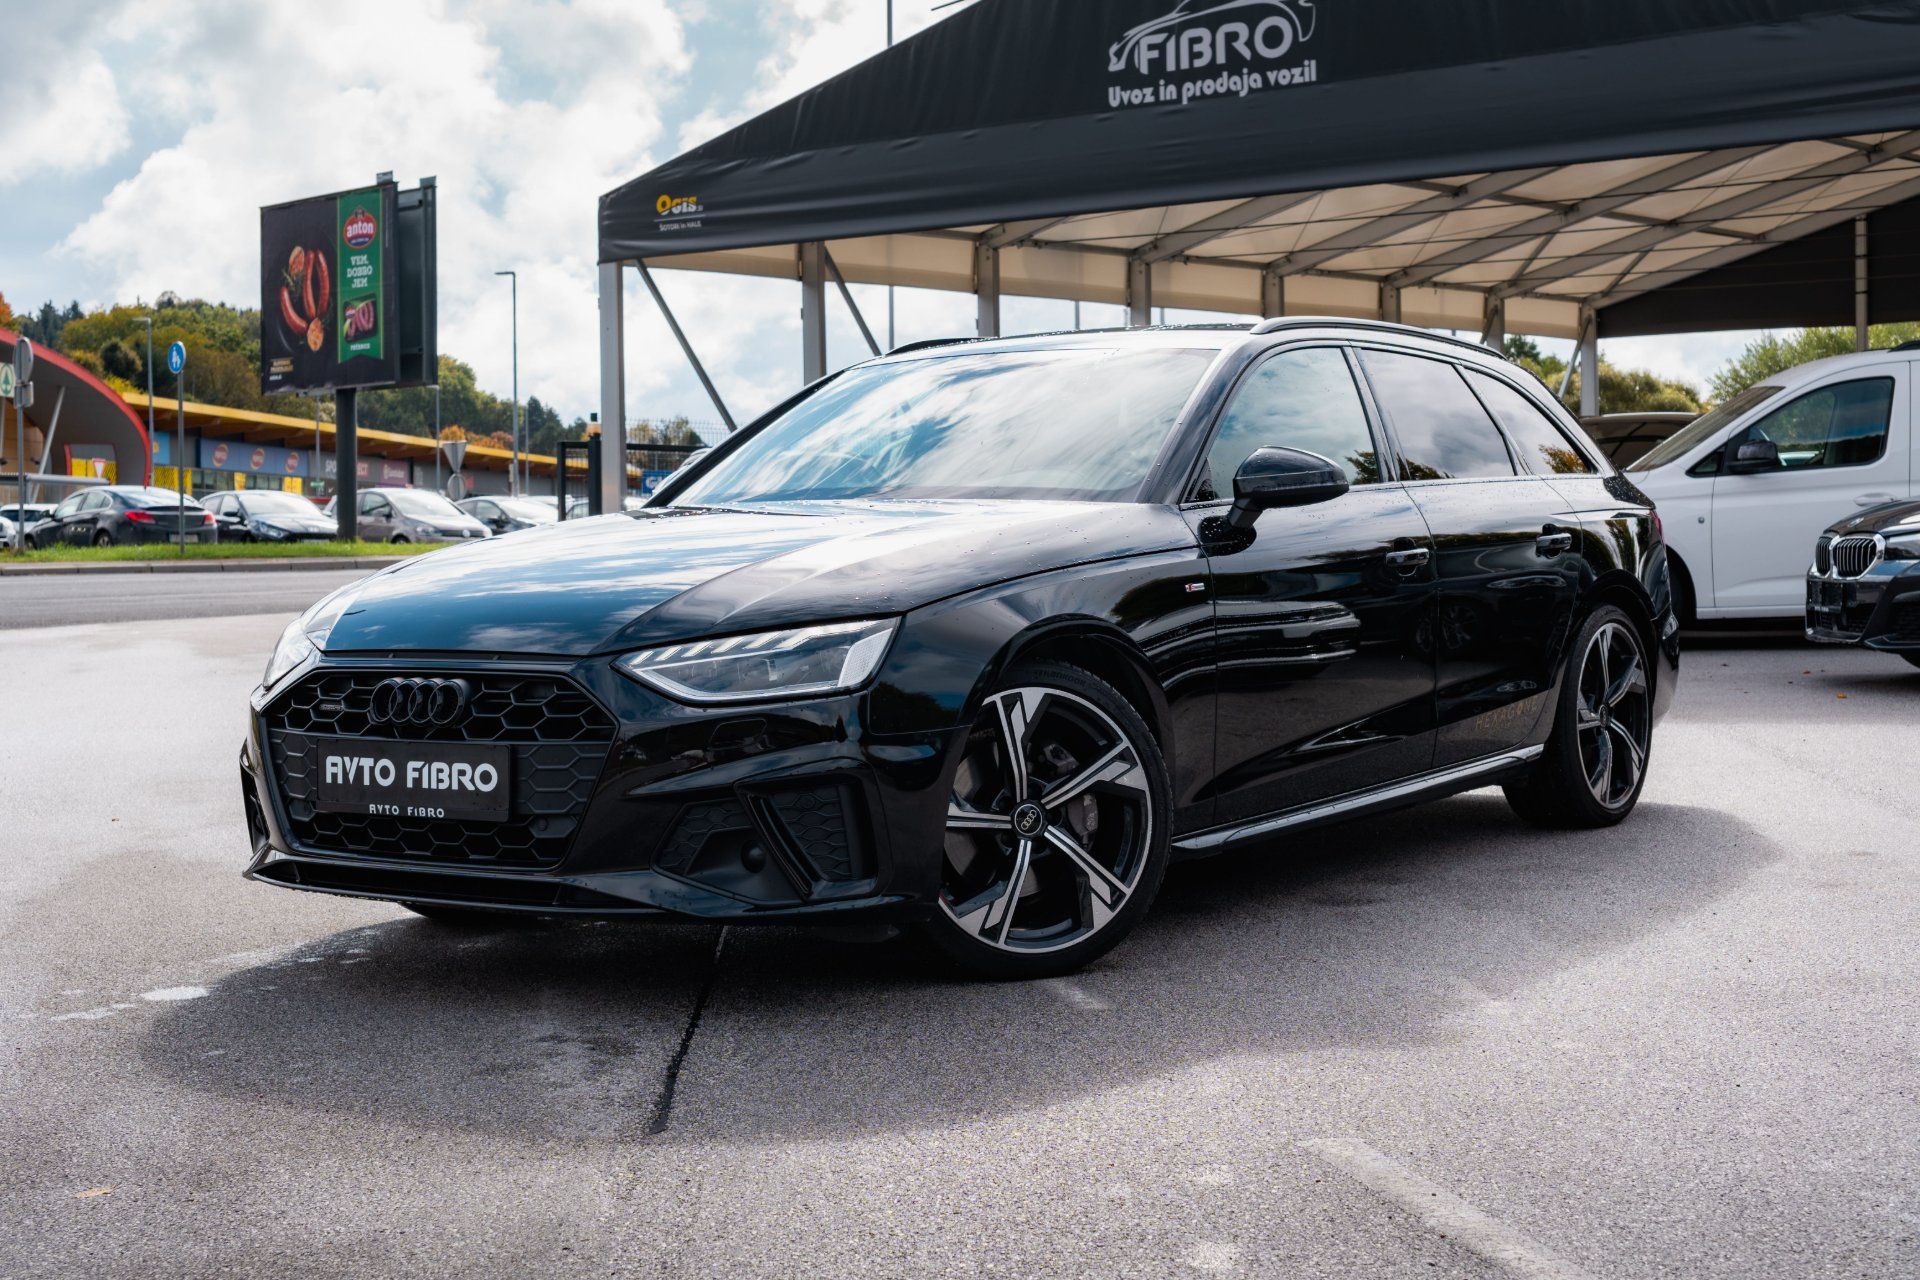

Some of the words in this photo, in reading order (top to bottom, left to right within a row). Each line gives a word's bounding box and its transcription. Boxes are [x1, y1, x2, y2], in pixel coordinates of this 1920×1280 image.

[1136, 15, 1294, 75] FIBRO
[1108, 85, 1155, 107] Uvoz
[1159, 79, 1177, 101] in
[1182, 68, 1262, 105] prodaja
[1266, 59, 1317, 86] vozil
[346, 220, 374, 238] anton
[325, 756, 396, 787] AVTO
[406, 760, 498, 792] FIBRO
[369, 803, 400, 815] AVTO
[407, 806, 445, 818] FIBRO
